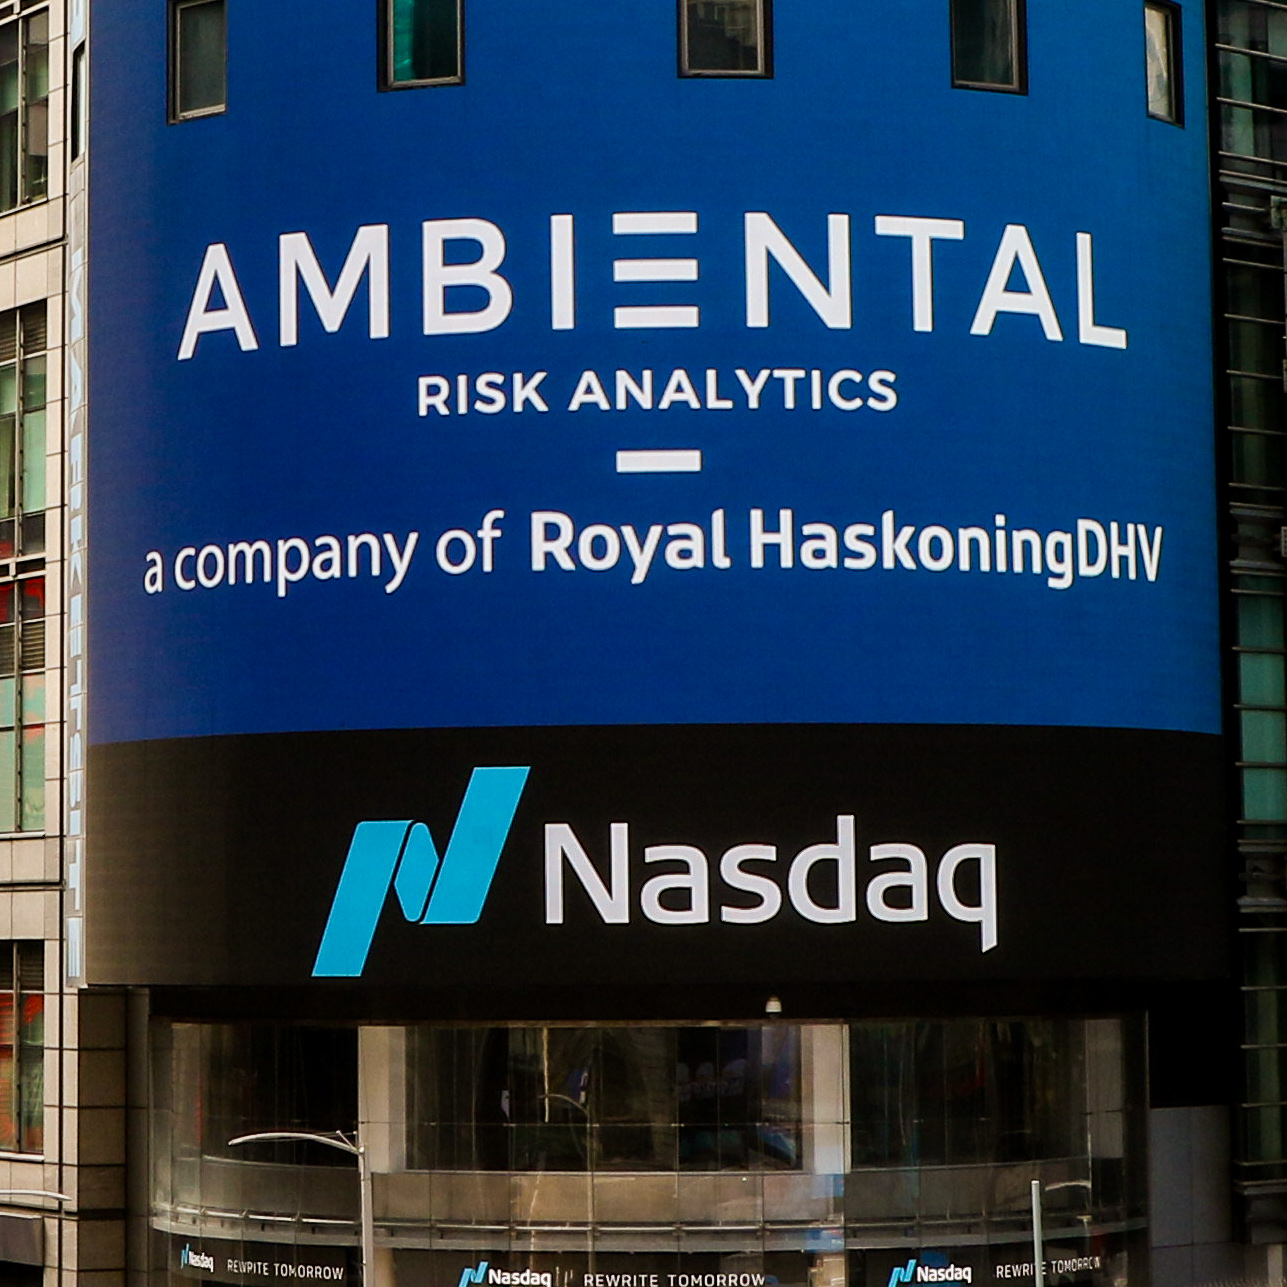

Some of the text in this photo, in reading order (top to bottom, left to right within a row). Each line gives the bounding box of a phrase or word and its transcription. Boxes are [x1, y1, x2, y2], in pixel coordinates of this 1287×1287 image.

[176, 211, 1128, 362] AMBIENTAL
[418, 369, 898, 418] RISK ANALYTICS
[144, 508, 1163, 598] a company of Royal HaskoningDHV
[544, 814, 999, 954] Nasdaq
[188, 1251, 215, 1273] Nasdaq
[273, 1262, 344, 1281] TOMORROW
[487, 1267, 765, 1287] Nasdaq REWRITE TOMORROW
[916, 1263, 973, 1284] Nasdaq
[995, 1261, 1047, 1279] REWRIE
